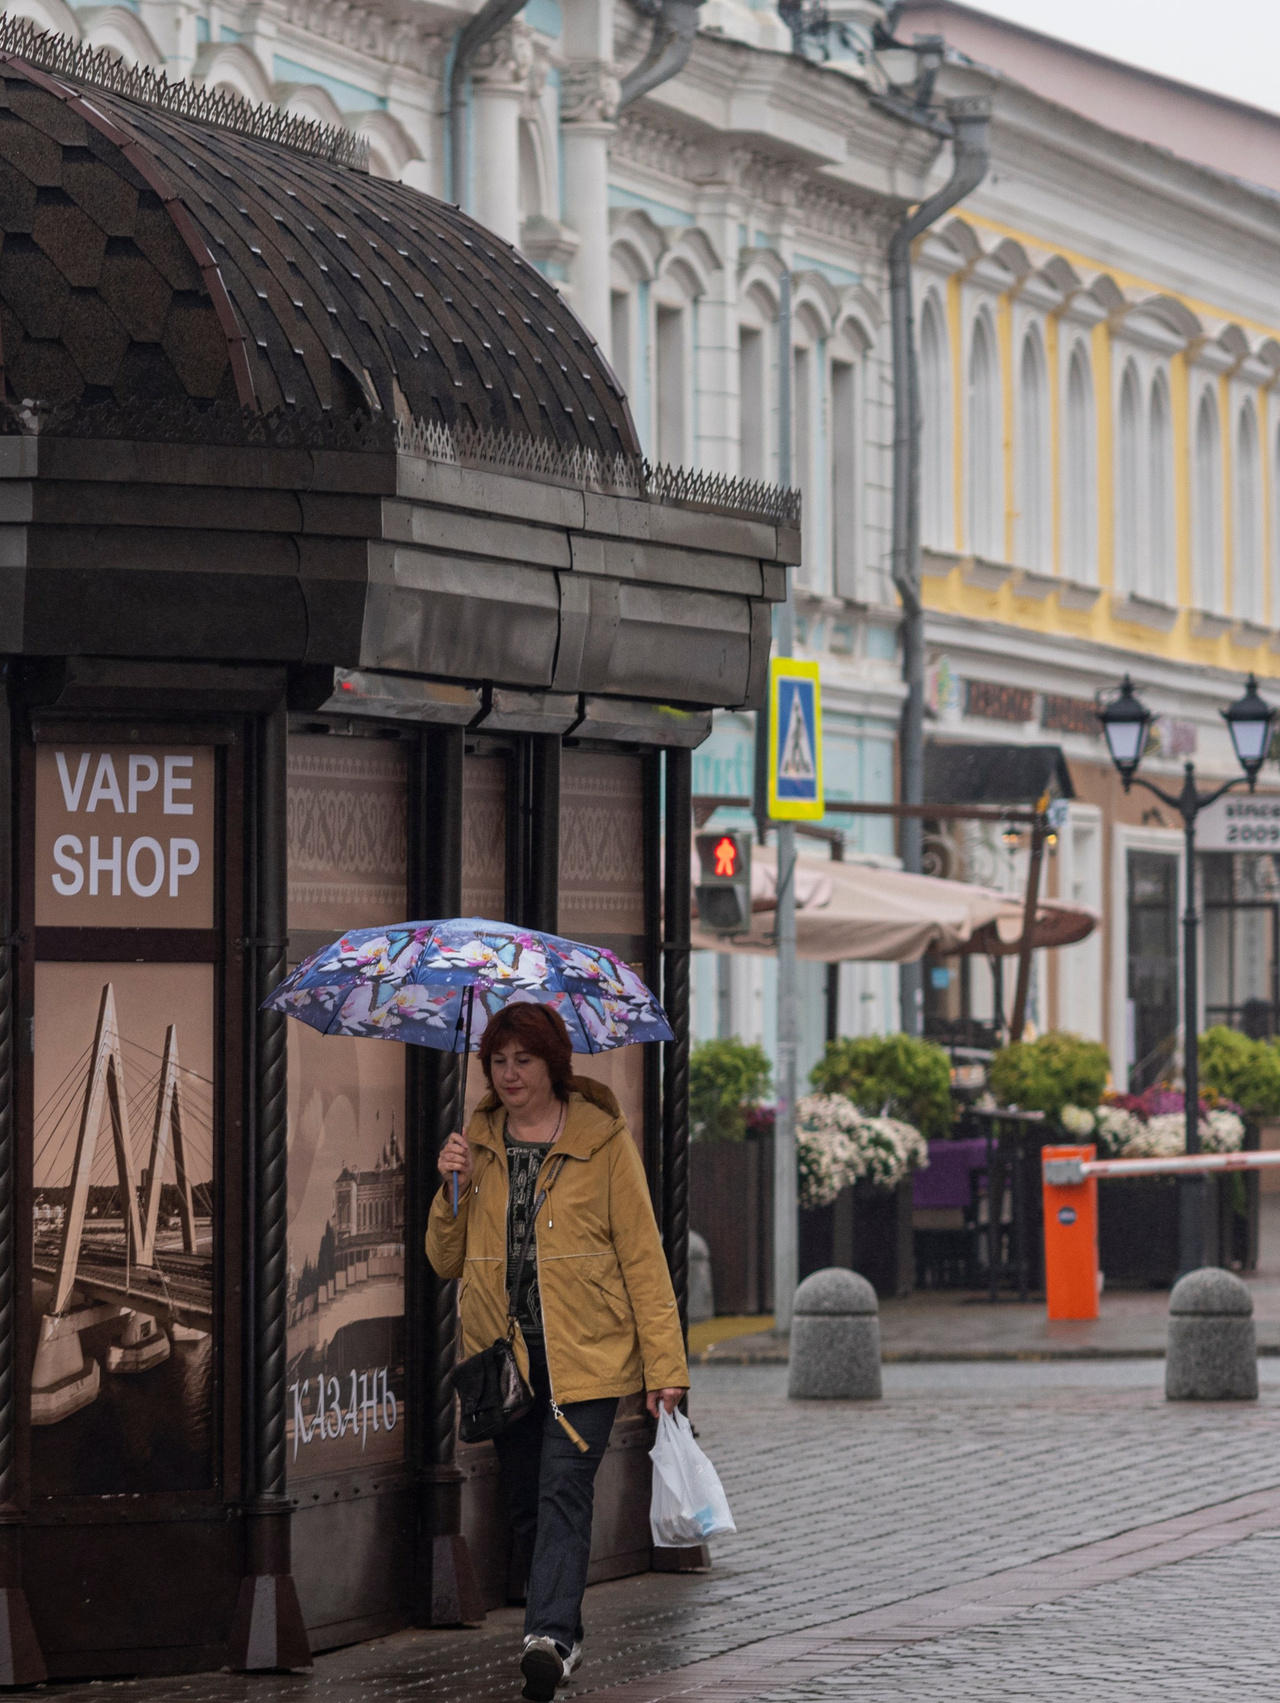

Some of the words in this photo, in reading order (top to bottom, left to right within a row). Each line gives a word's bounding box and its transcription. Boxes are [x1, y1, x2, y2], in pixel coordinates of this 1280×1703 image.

[55, 752, 194, 815] VAPE
[51, 834, 200, 898] SHOP
[289, 1365, 397, 1465] КАЗАНЬ
